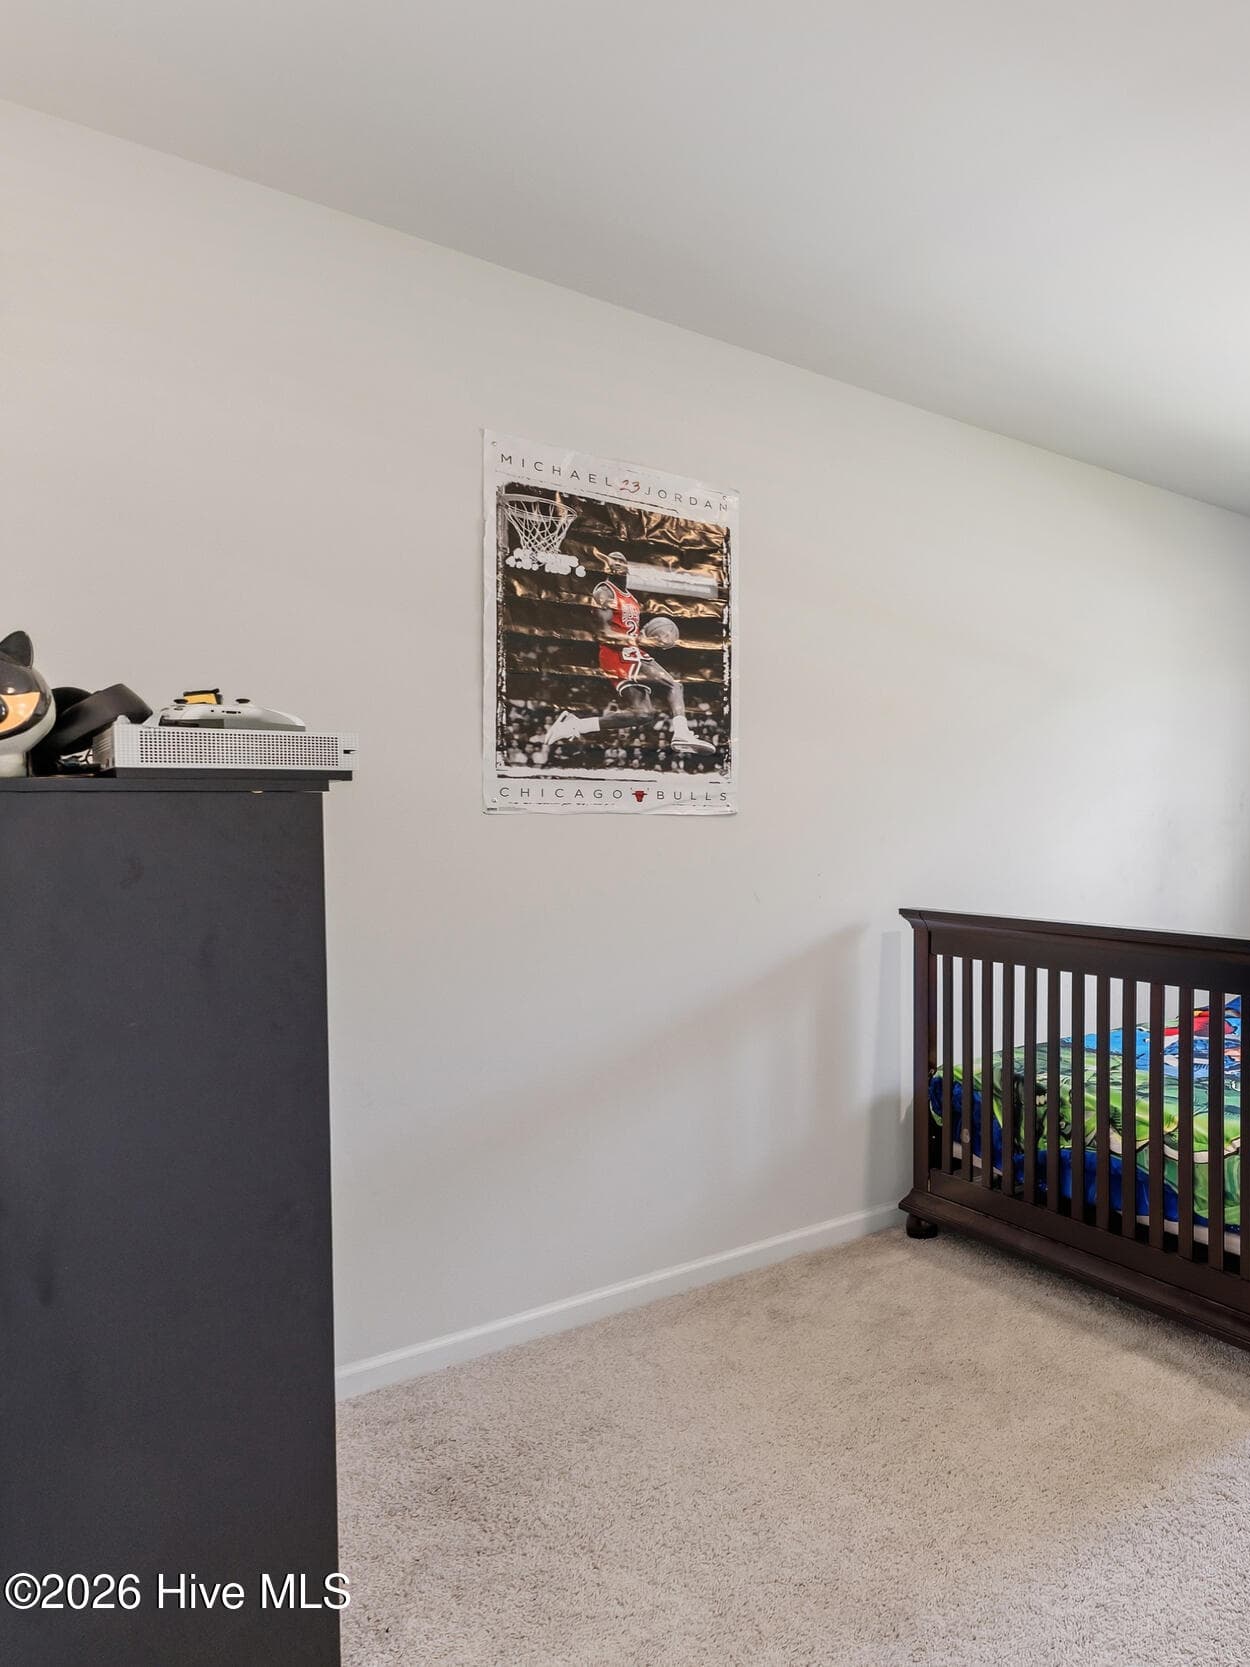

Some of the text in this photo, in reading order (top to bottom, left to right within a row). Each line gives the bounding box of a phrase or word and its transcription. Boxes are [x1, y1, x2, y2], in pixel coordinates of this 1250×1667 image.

[500, 453, 729, 512] MICHAEL 23 JORDAN
[499, 786, 728, 802] CHICAGO BULLS
